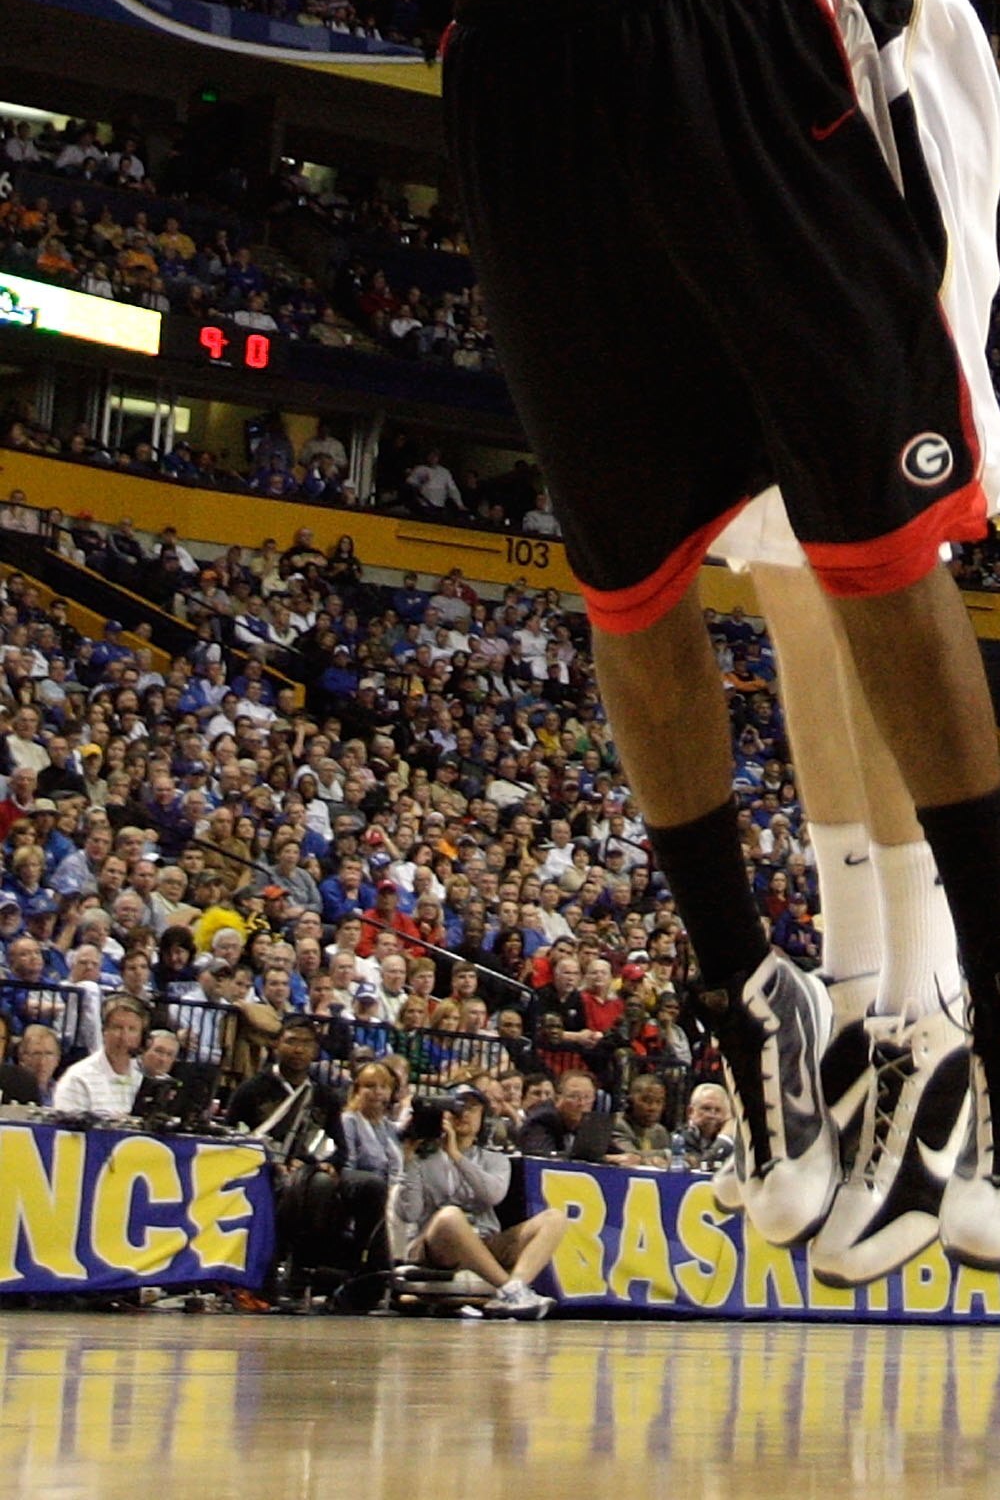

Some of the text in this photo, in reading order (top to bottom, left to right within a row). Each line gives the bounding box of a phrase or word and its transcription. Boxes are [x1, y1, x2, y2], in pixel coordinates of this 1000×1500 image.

[902, 432, 953, 486] G
[505, 537, 549, 569] 103
[0, 1125, 267, 1281] NCE
